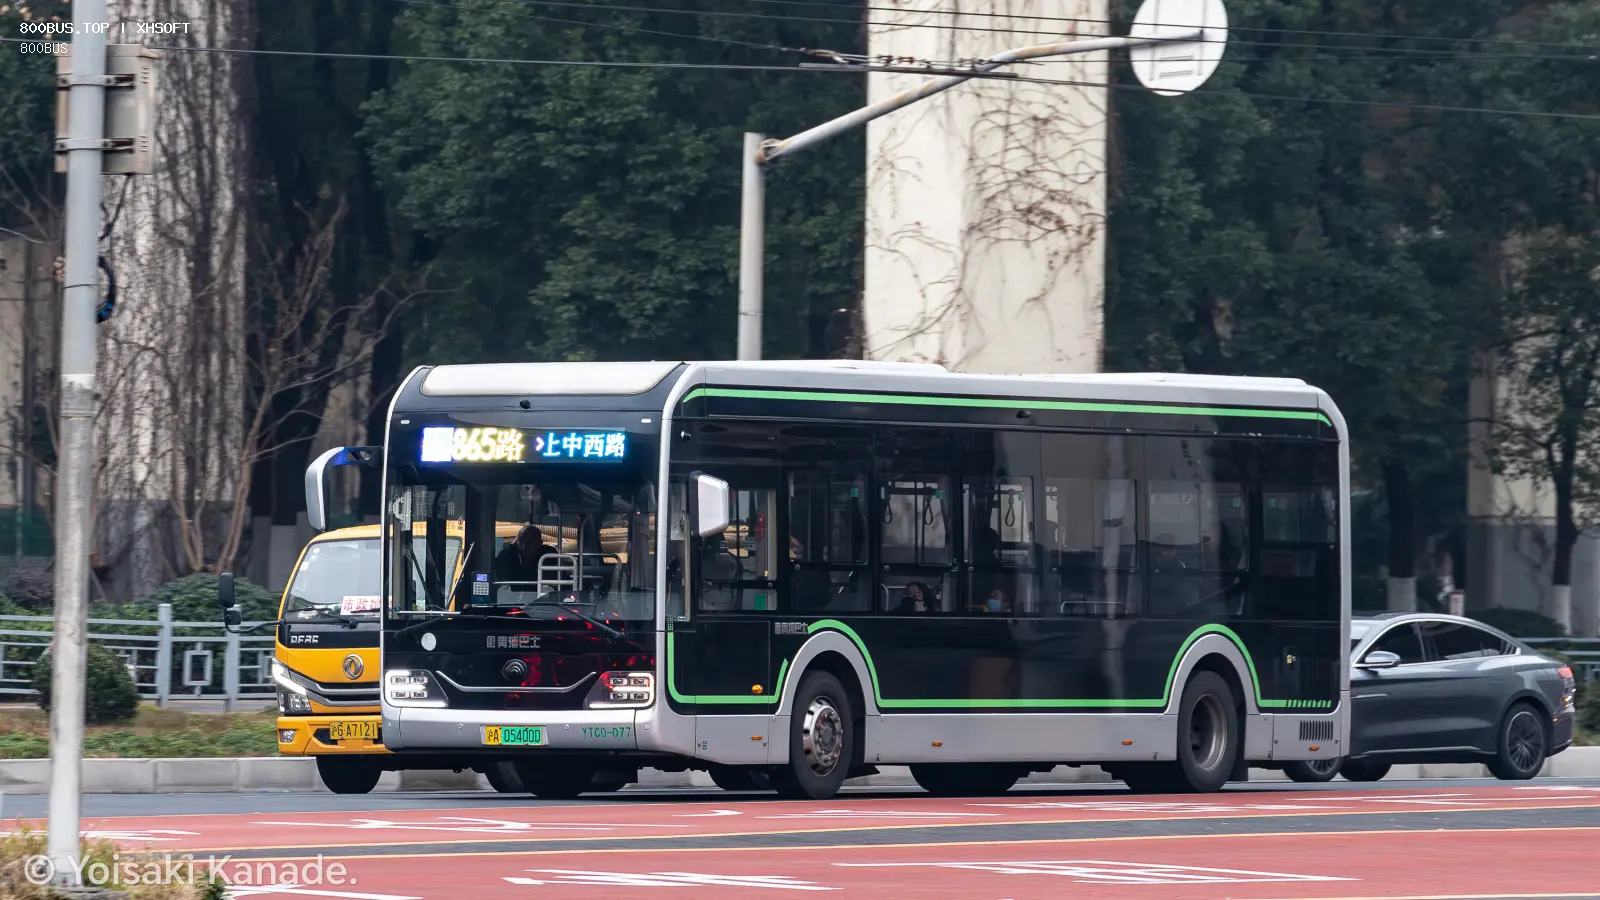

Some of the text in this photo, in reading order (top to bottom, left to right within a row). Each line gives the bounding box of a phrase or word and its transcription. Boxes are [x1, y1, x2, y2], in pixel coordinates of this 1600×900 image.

[452, 427, 626, 461] 865路 上中西路
